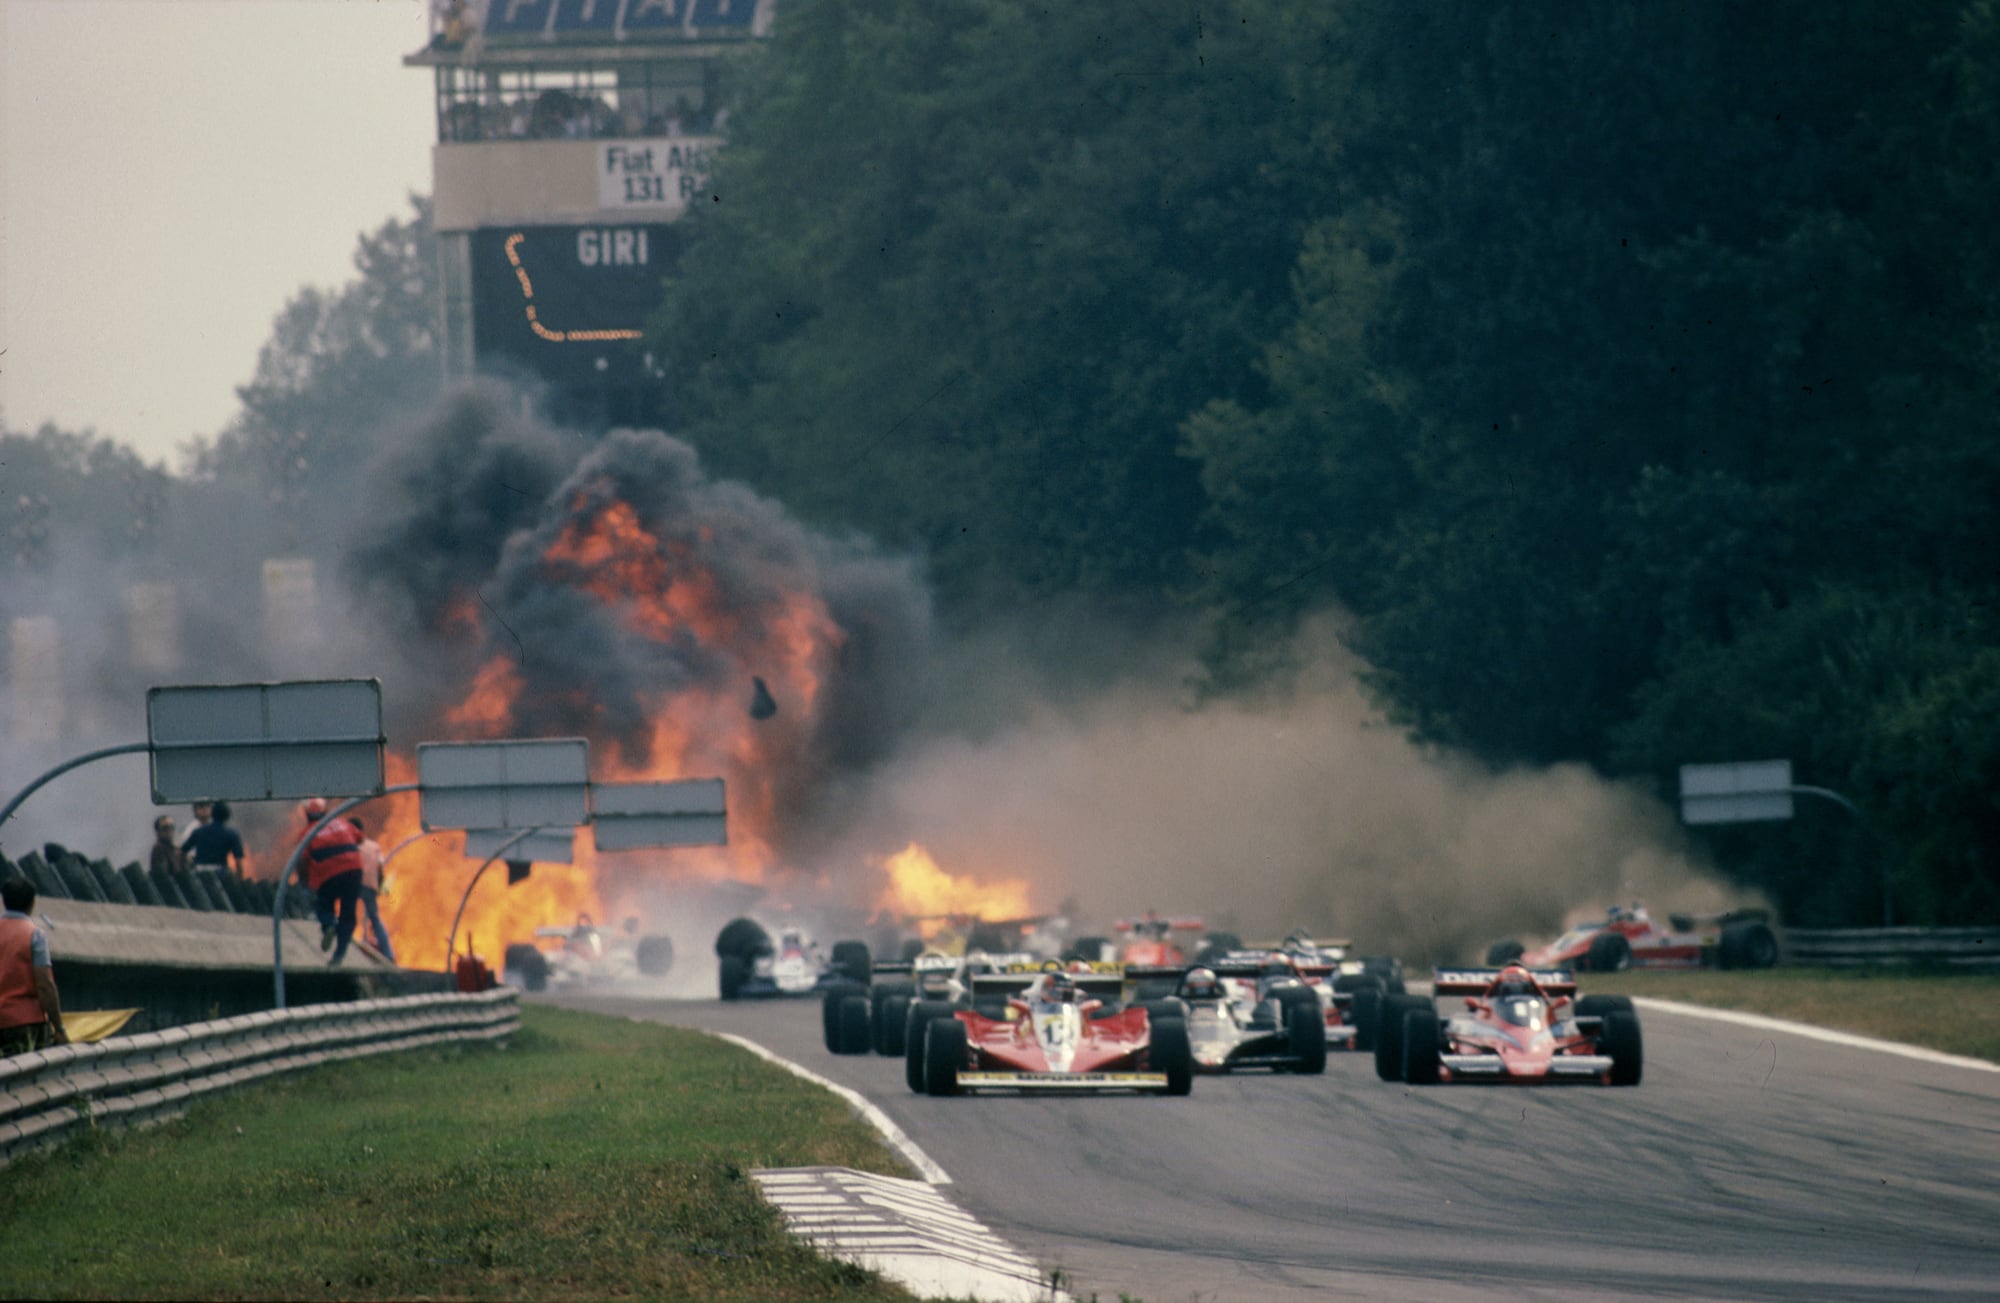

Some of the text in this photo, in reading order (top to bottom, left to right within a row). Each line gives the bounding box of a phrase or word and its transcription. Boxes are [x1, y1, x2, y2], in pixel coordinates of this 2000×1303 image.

[607, 147, 653, 173] Fiat
[624, 176, 663, 201] 131
[577, 229, 649, 266] GIRI
